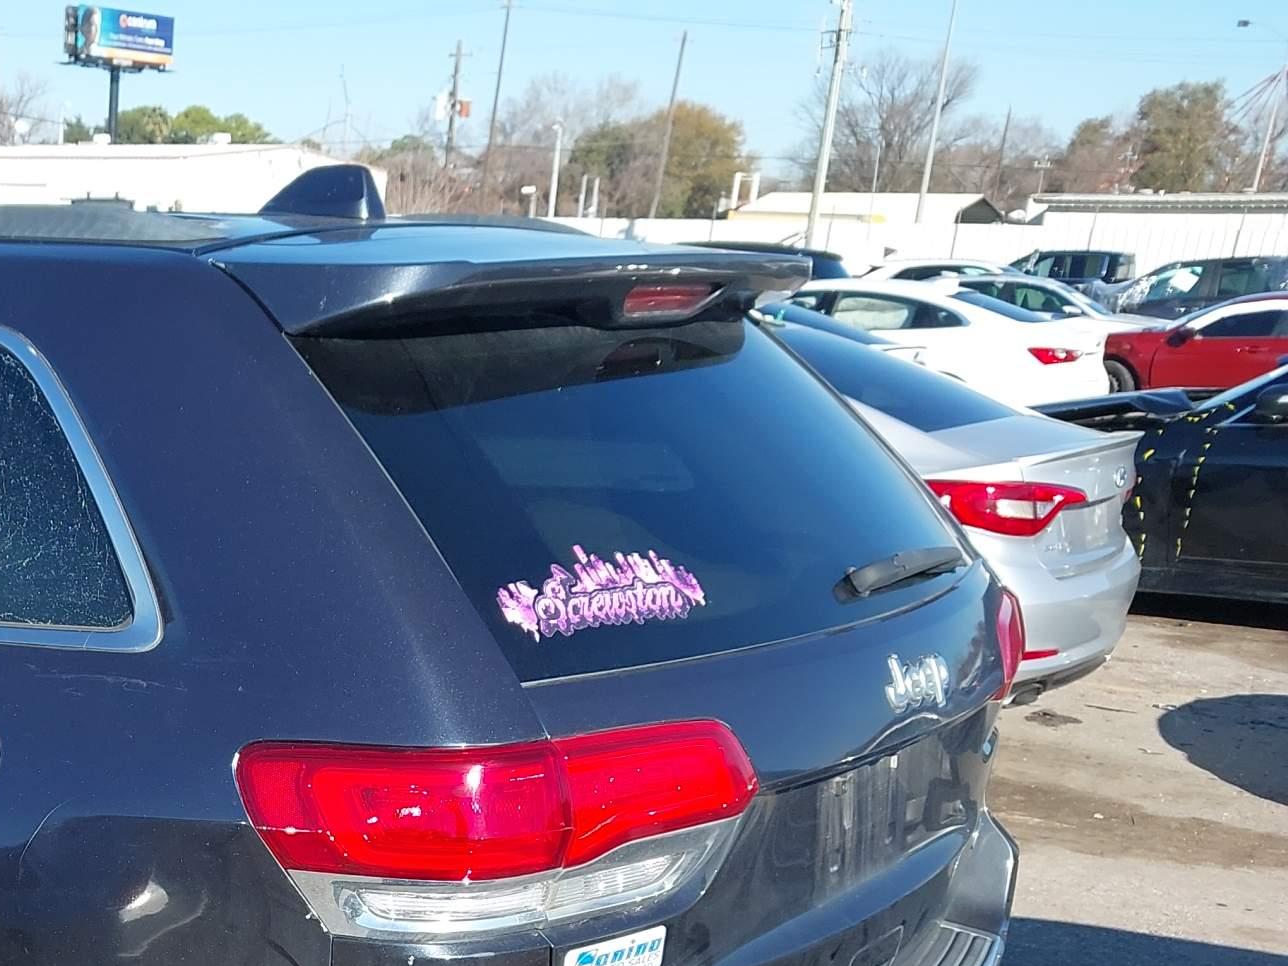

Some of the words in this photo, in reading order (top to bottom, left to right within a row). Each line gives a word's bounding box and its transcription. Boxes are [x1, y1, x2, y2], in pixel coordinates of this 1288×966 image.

[535, 563, 691, 637] Screwston
[885, 653, 950, 715] Jeep
[628, 950, 661, 966] SALES
